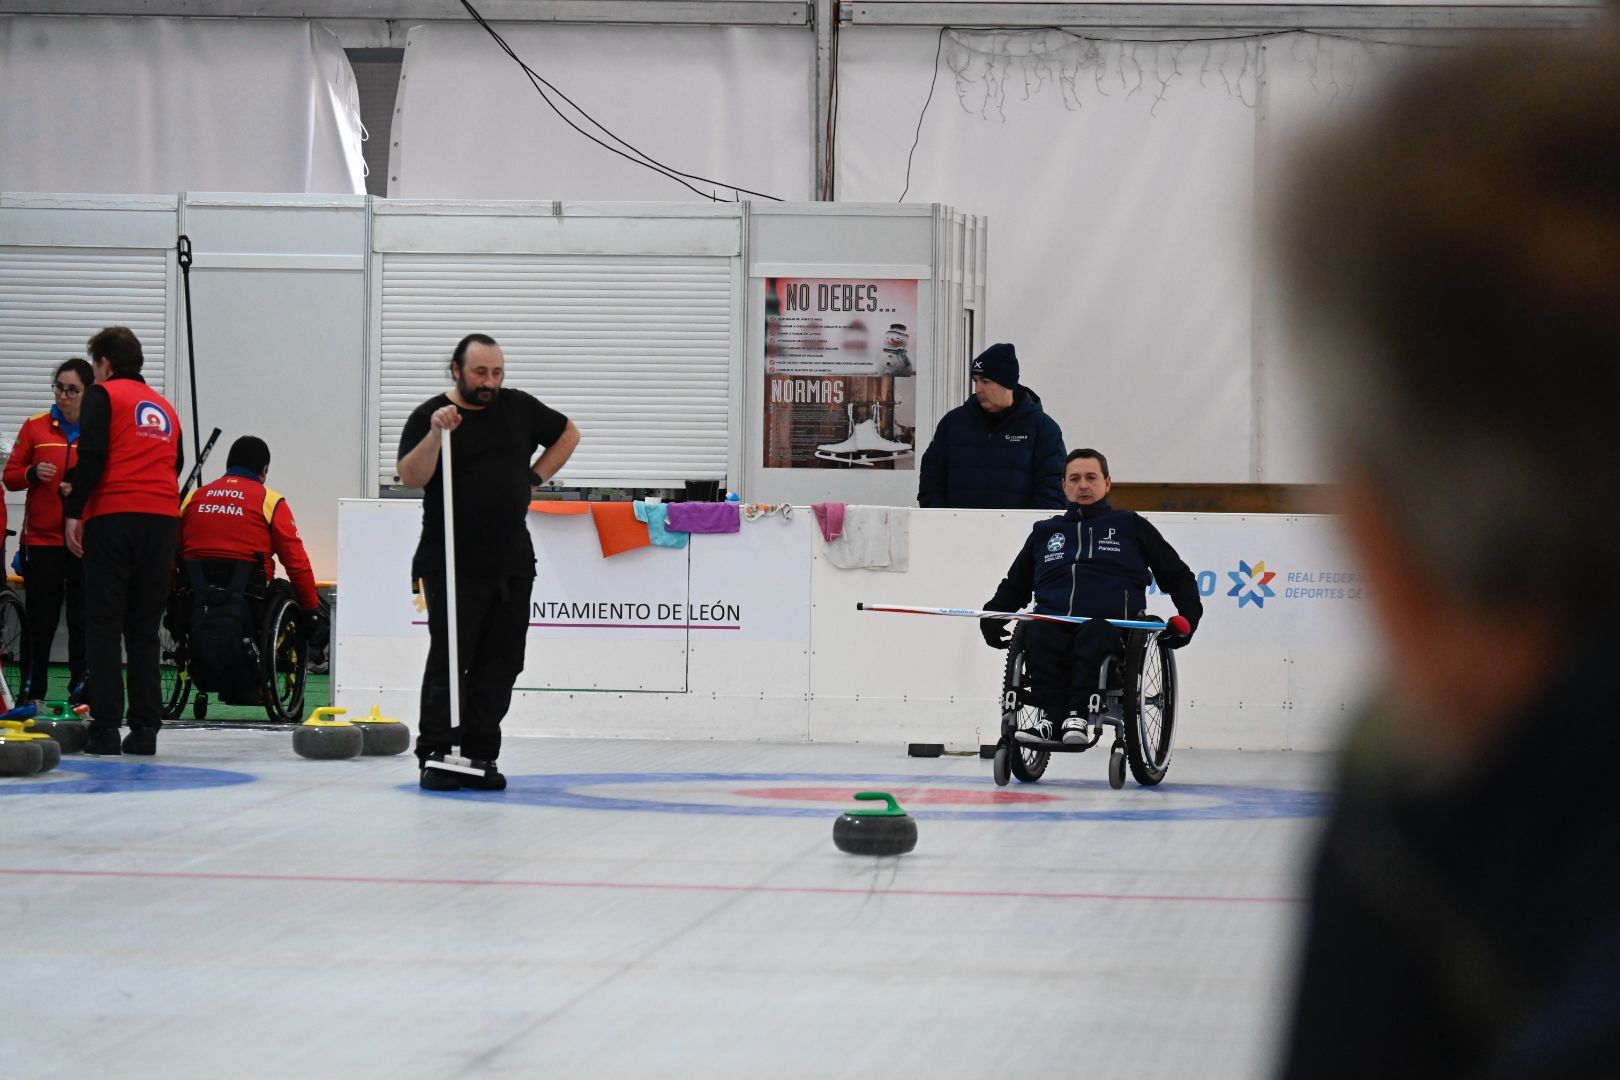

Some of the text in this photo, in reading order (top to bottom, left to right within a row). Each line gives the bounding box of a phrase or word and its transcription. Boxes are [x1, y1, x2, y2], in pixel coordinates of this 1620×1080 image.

[786, 283, 810, 311] NO
[771, 379, 844, 404] NORMAS
[206, 489, 245, 500] PINYOL
[198, 503, 244, 516] ESPAÑA
[1287, 572, 1315, 583] REAL
[1285, 587, 1344, 599] DEPORTES
[532, 600, 740, 621] NTAMIENTO DE LEÓN
